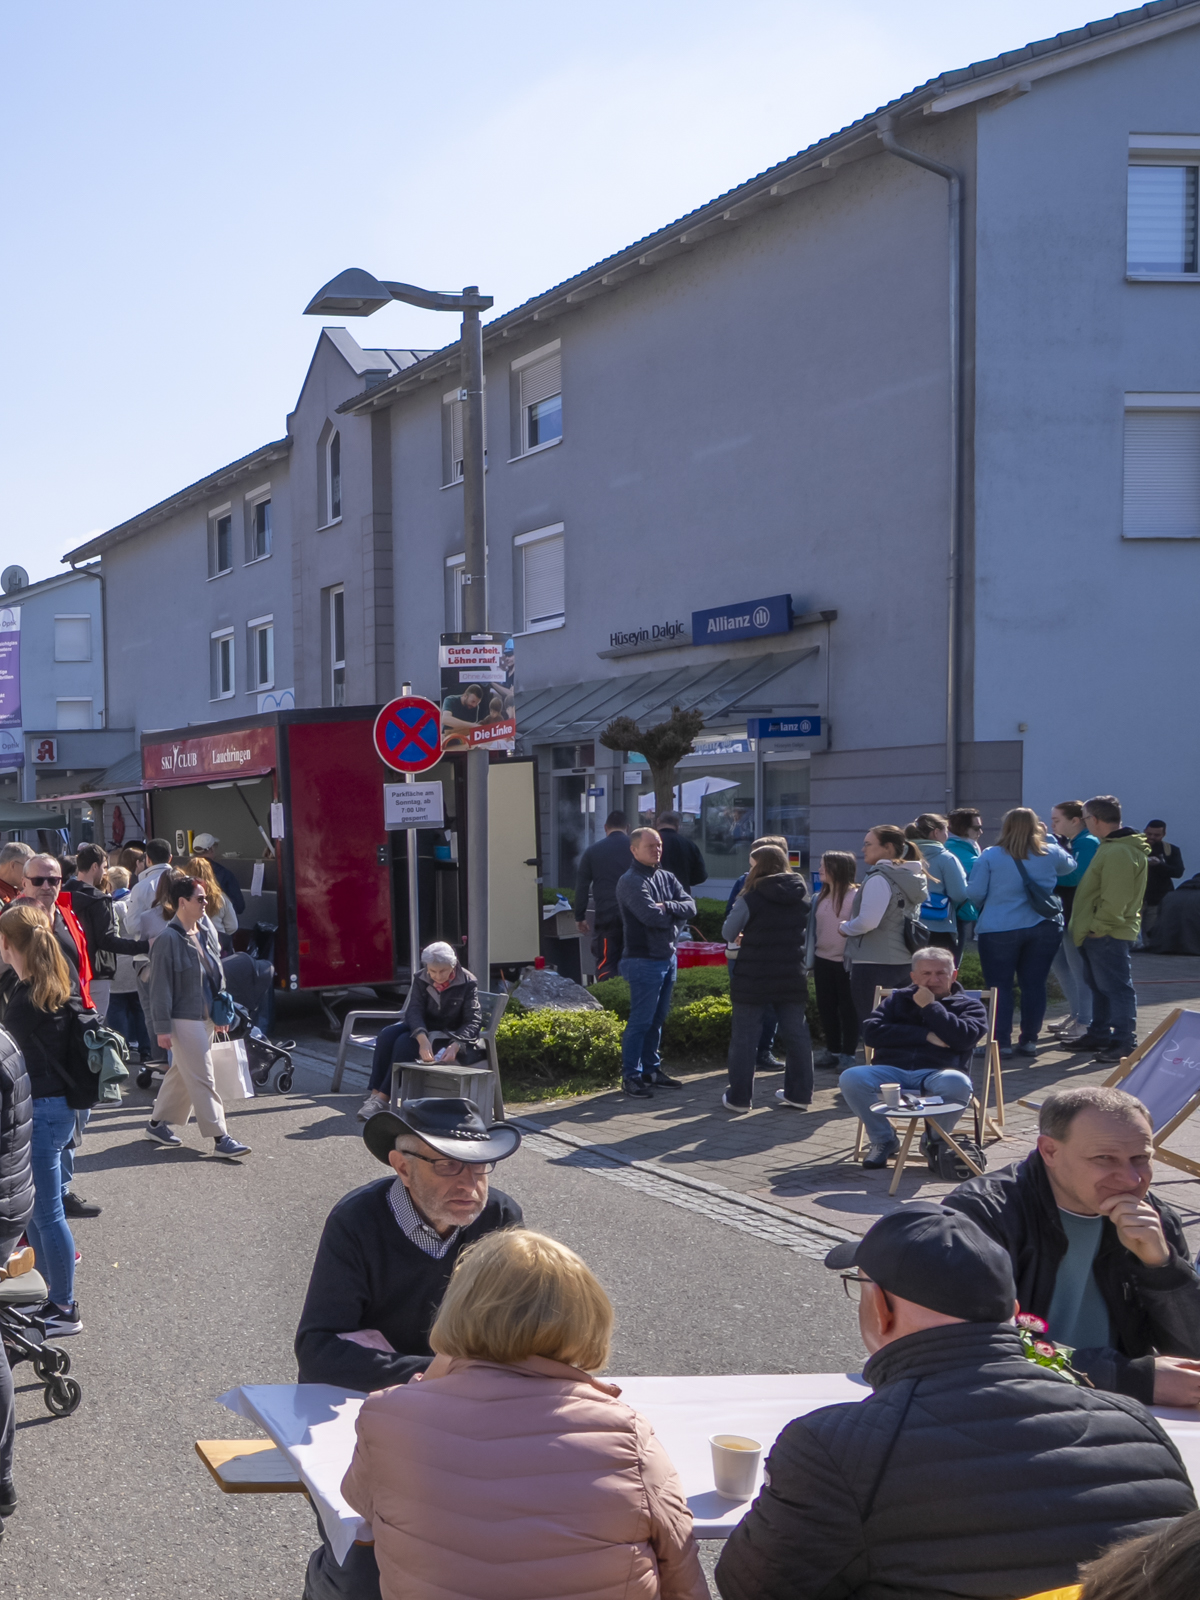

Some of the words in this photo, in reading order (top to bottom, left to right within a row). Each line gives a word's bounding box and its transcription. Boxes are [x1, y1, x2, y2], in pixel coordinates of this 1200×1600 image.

[707, 614, 751, 634] Allianz
[610, 627, 649, 647] Hüseyin
[652, 620, 685, 639] Dalgic
[472, 646, 500, 654] Arbeit.
[448, 657, 477, 665] Löhne
[478, 656, 497, 664] rauf.
[474, 730, 490, 741] Die
[492, 724, 513, 737] Linke
[768, 722, 799, 732] ianz
[161, 756, 173, 770] SKI
[178, 752, 198, 768] CLUB
[212, 747, 251, 765] Lauchringen
